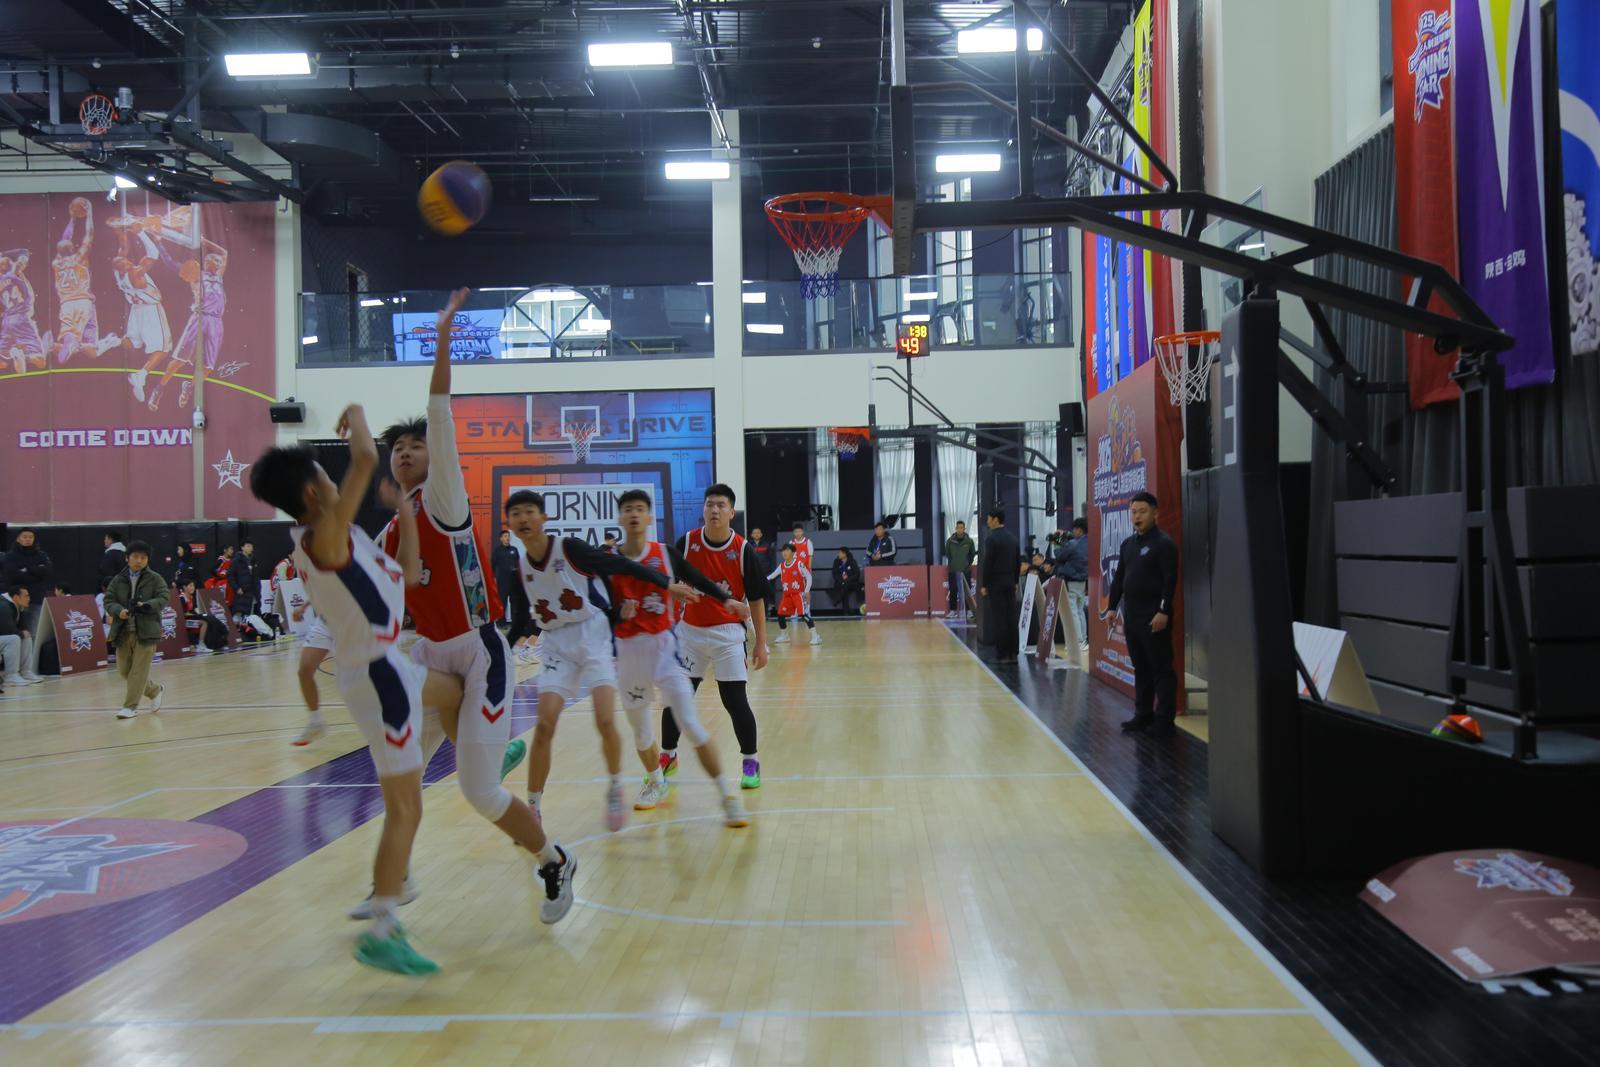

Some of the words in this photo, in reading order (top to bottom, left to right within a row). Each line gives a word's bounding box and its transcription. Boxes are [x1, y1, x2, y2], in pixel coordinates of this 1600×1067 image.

[909, 325, 927, 338] 1:38
[466, 420, 541, 437] STAR
[619, 415, 706, 433] DRIVE
[19, 430, 107, 448] COME
[114, 428, 193, 447] DOWN
[543, 491, 620, 521] ORNIN
